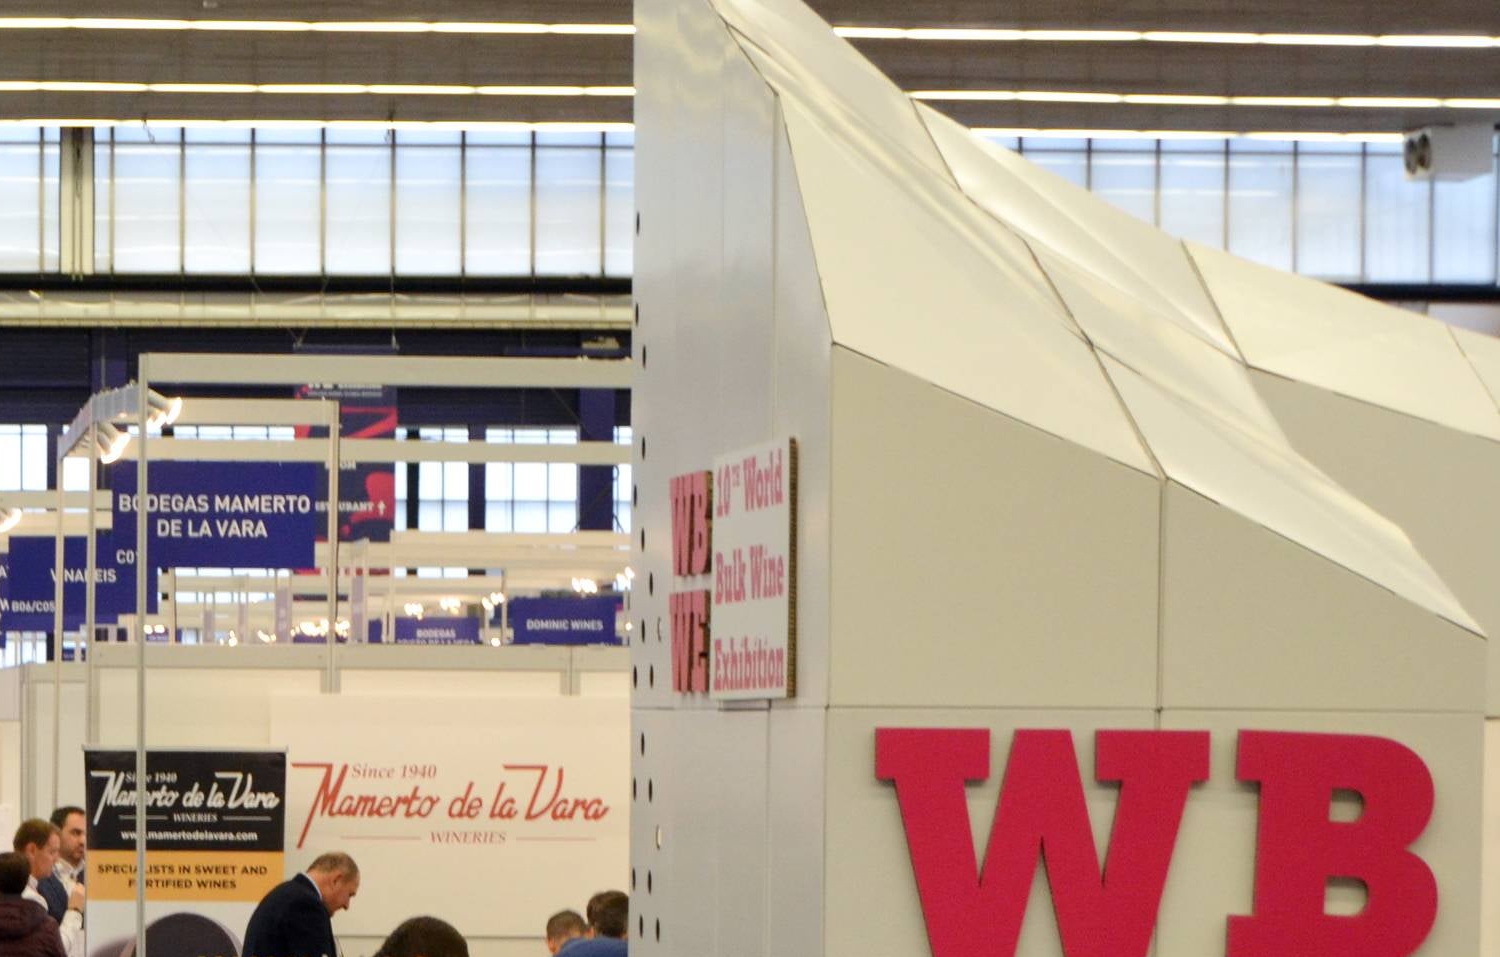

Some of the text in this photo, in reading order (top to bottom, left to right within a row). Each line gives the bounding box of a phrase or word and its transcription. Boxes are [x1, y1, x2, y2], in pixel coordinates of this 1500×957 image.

[743, 448, 783, 512] World
[215, 494, 310, 513] MAMERTO
[157, 519, 268, 537] DE LA VARA
[669, 470, 712, 576] WB
[715, 544, 784, 604] Bulk Wine
[526, 619, 604, 631] DOMINIC WINES
[669, 590, 710, 693] WE
[714, 636, 784, 690] Exhibition
[125, 771, 178, 783] Sie 1940
[351, 763, 437, 779] Since 1940
[90, 770, 280, 826] Mamrto de la Vara
[291, 763, 610, 849] Mamerto de la Vara
[173, 813, 218, 822] WINERIES
[121, 830, 258, 841] ww.mamertodelavara.com
[431, 831, 507, 844] WINERIES
[179, 865, 191, 874] IN
[195, 865, 236, 875] SWEET
[241, 866, 268, 875] AND
[129, 879, 237, 889] FRTIFIED WINES
